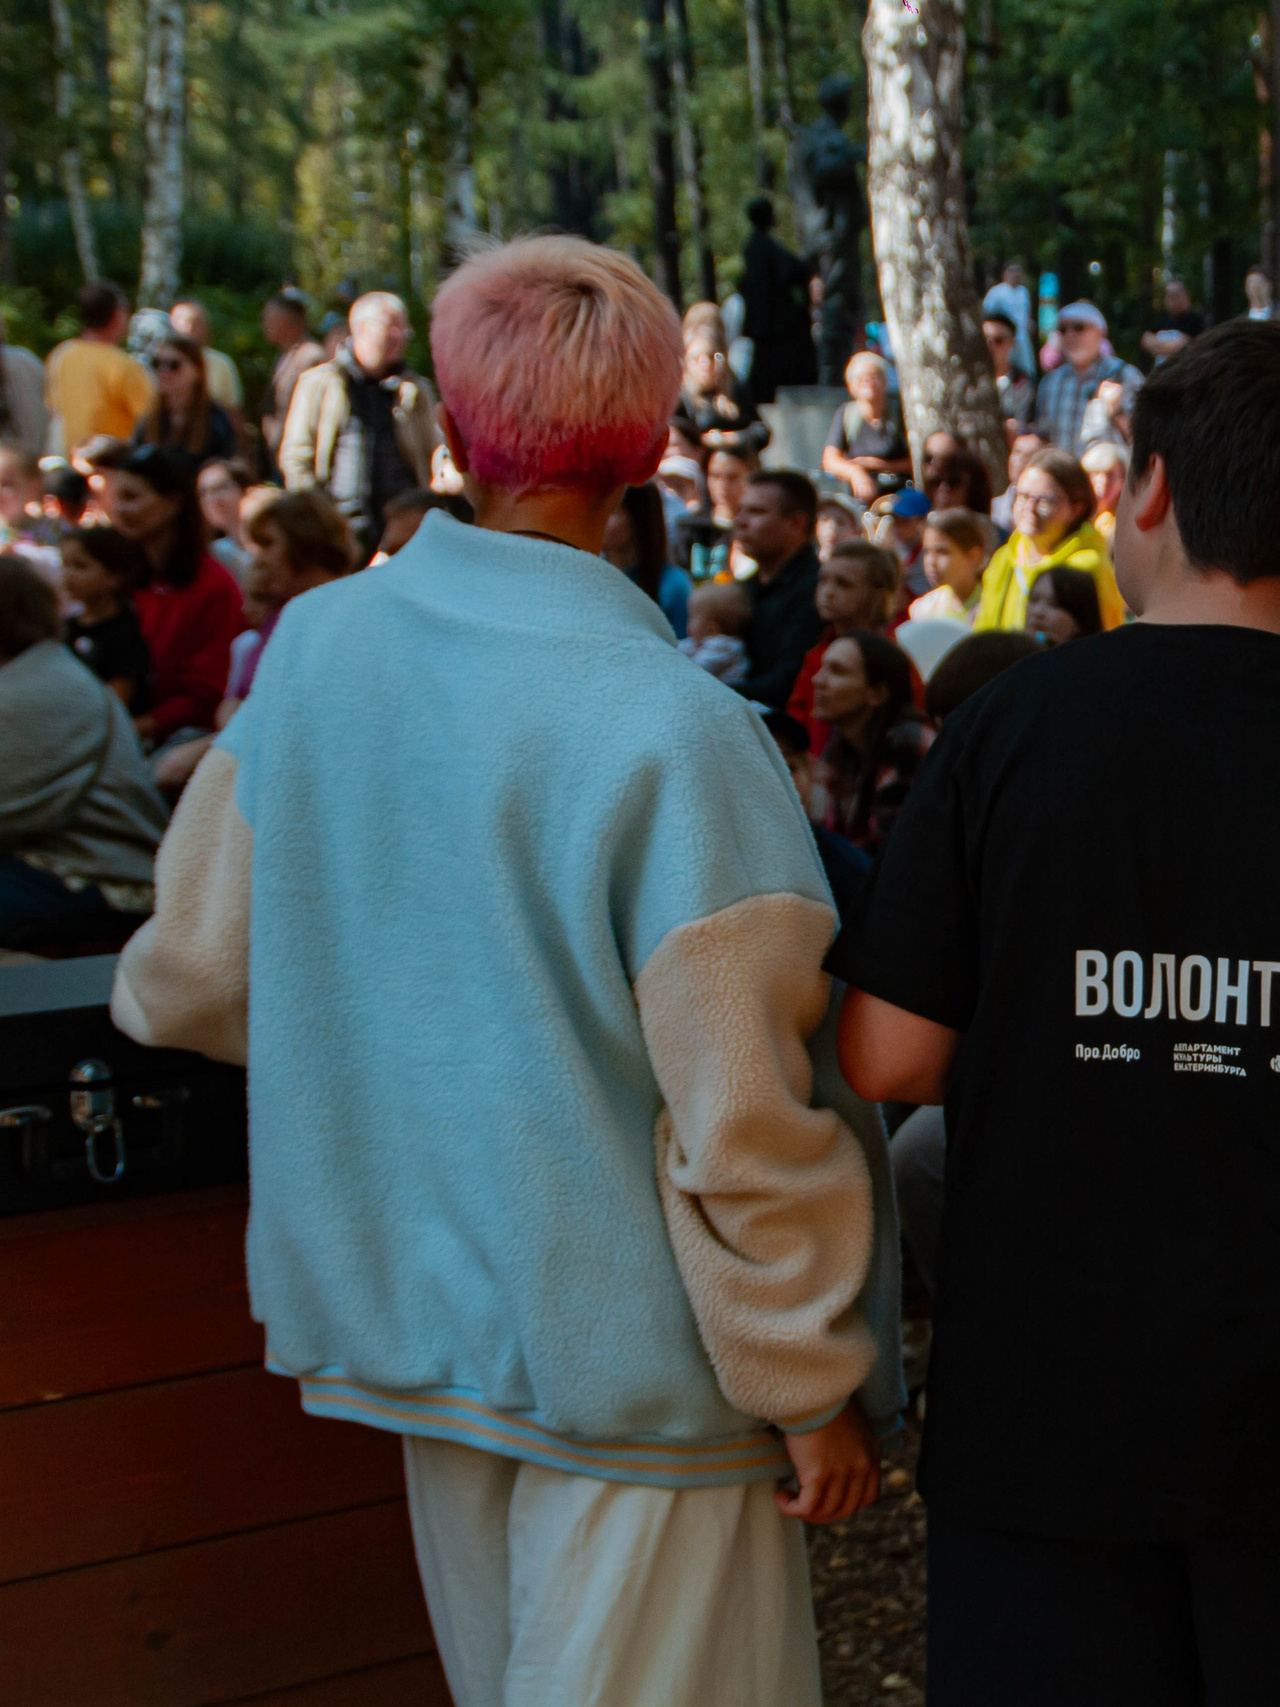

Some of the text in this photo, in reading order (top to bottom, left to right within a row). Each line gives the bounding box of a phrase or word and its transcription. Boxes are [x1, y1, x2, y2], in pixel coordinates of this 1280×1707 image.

[1173, 1042, 1241, 1056] ДЕПАРТАМЕНТ
[1173, 1053, 1222, 1064] КУЛЬТУРЫ
[1173, 1062, 1247, 1077] ЕКАТЕРИНБУРГА
